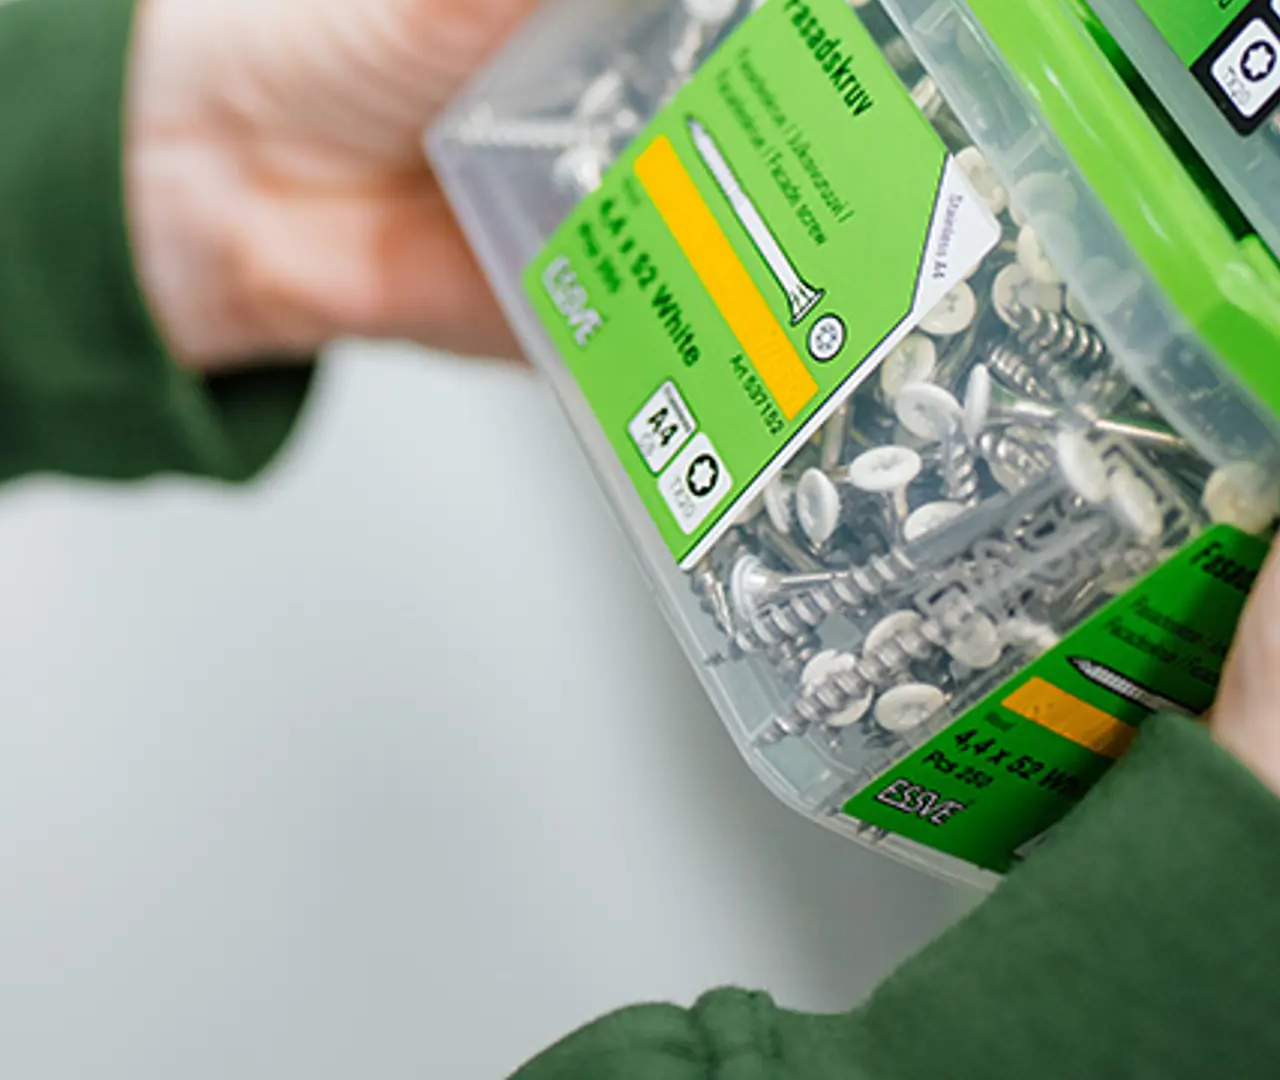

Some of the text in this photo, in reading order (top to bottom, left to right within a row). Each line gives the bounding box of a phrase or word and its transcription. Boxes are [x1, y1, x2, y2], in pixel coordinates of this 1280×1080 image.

[932, 261, 947, 279] A4
[651, 284, 700, 367] White
[648, 407, 679, 447] A4
[954, 729, 997, 756] 4,4
[987, 749, 1011, 765] x
[1006, 755, 1046, 780] 52
[876, 779, 964, 825] ESSVE
